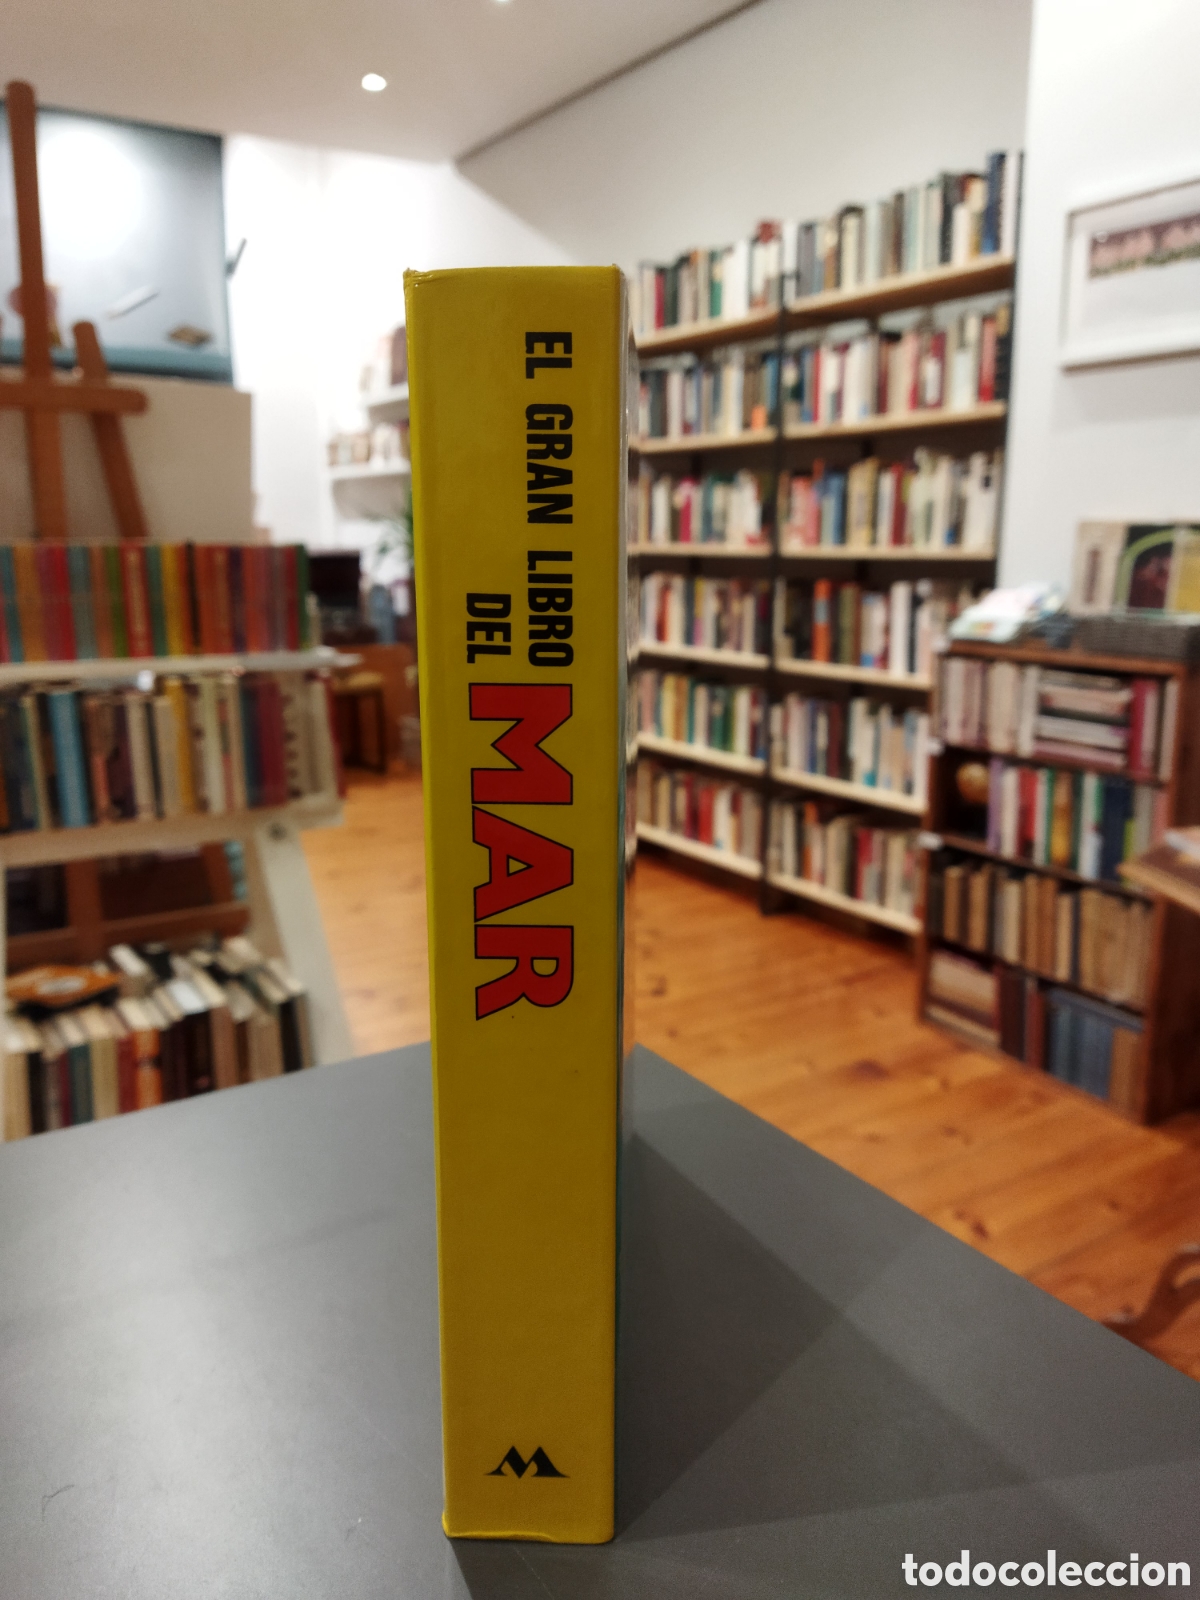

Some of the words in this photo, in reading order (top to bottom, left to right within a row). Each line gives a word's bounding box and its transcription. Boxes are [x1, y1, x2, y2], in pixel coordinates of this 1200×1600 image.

[524, 331, 573, 380] EL
[524, 403, 574, 525] GRAN
[466, 592, 512, 665] DEL
[527, 549, 574, 667] LIBRO
[469, 682, 574, 1021] MAR
